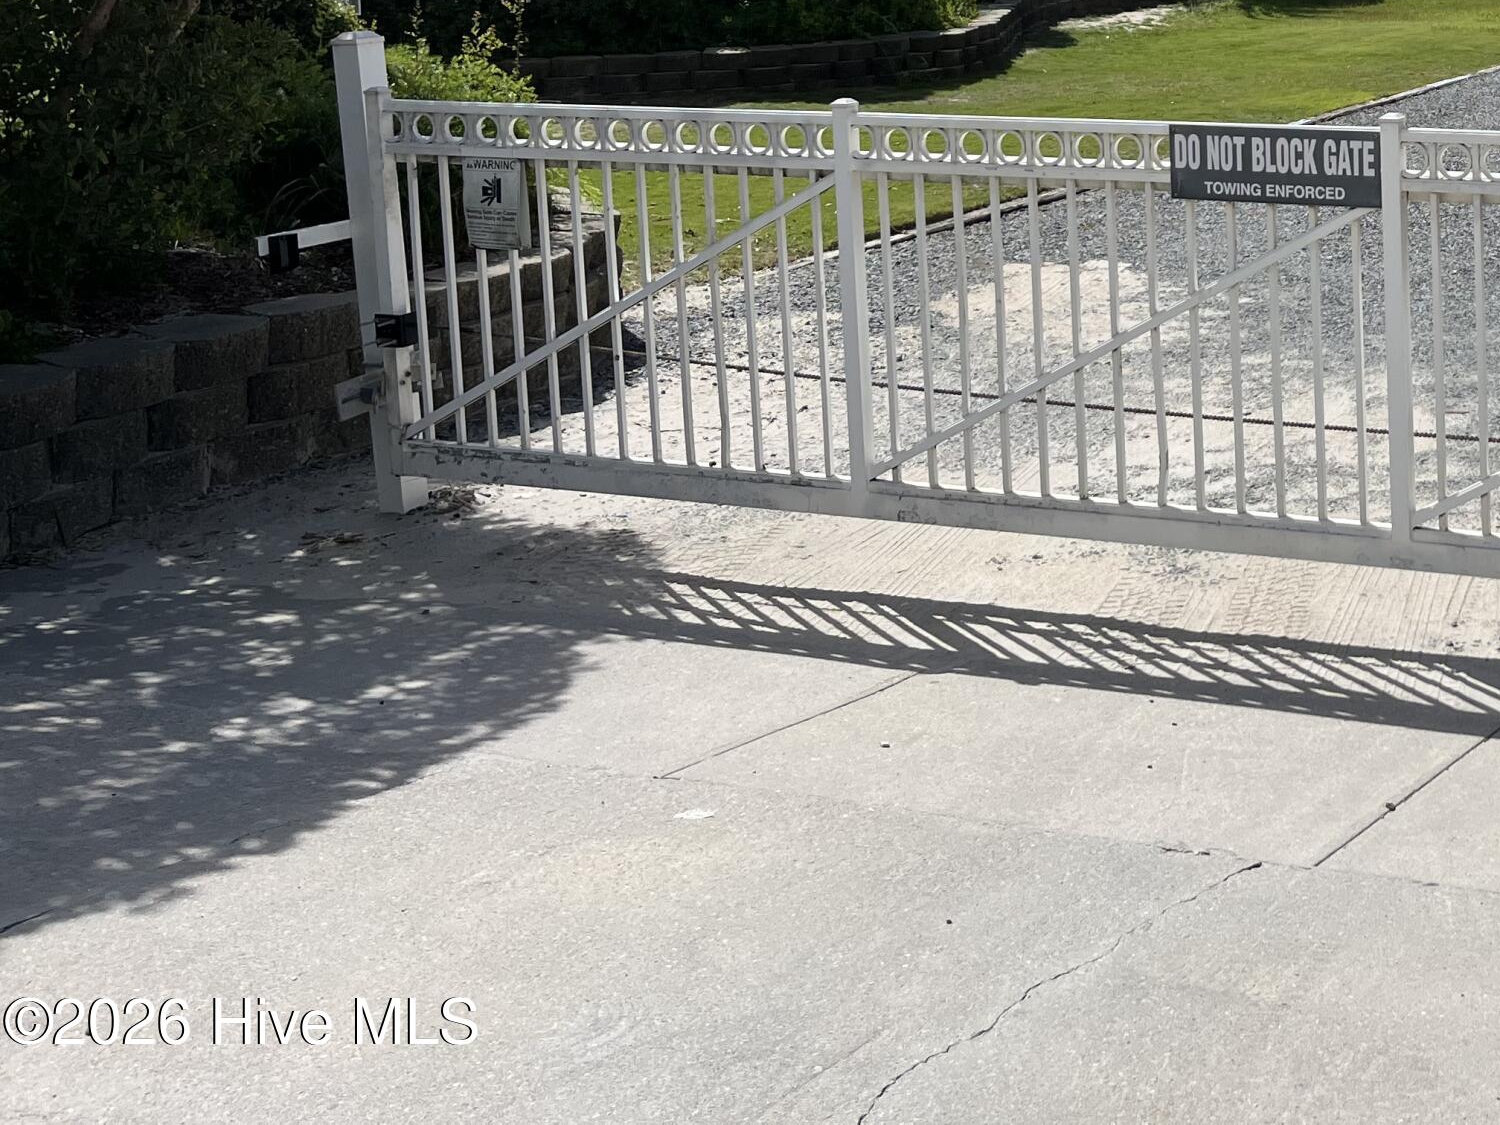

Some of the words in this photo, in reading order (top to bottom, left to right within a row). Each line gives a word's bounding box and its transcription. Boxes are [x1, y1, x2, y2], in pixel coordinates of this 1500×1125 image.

[473, 159, 516, 170] WARNING
[1174, 133, 1200, 170] DO
[1206, 134, 1245, 172] NOT
[1251, 136, 1318, 175] BLOCK
[1323, 138, 1376, 177] GATE
[1204, 181, 1262, 197] TOWING
[1266, 182, 1346, 200] ENFORCED
